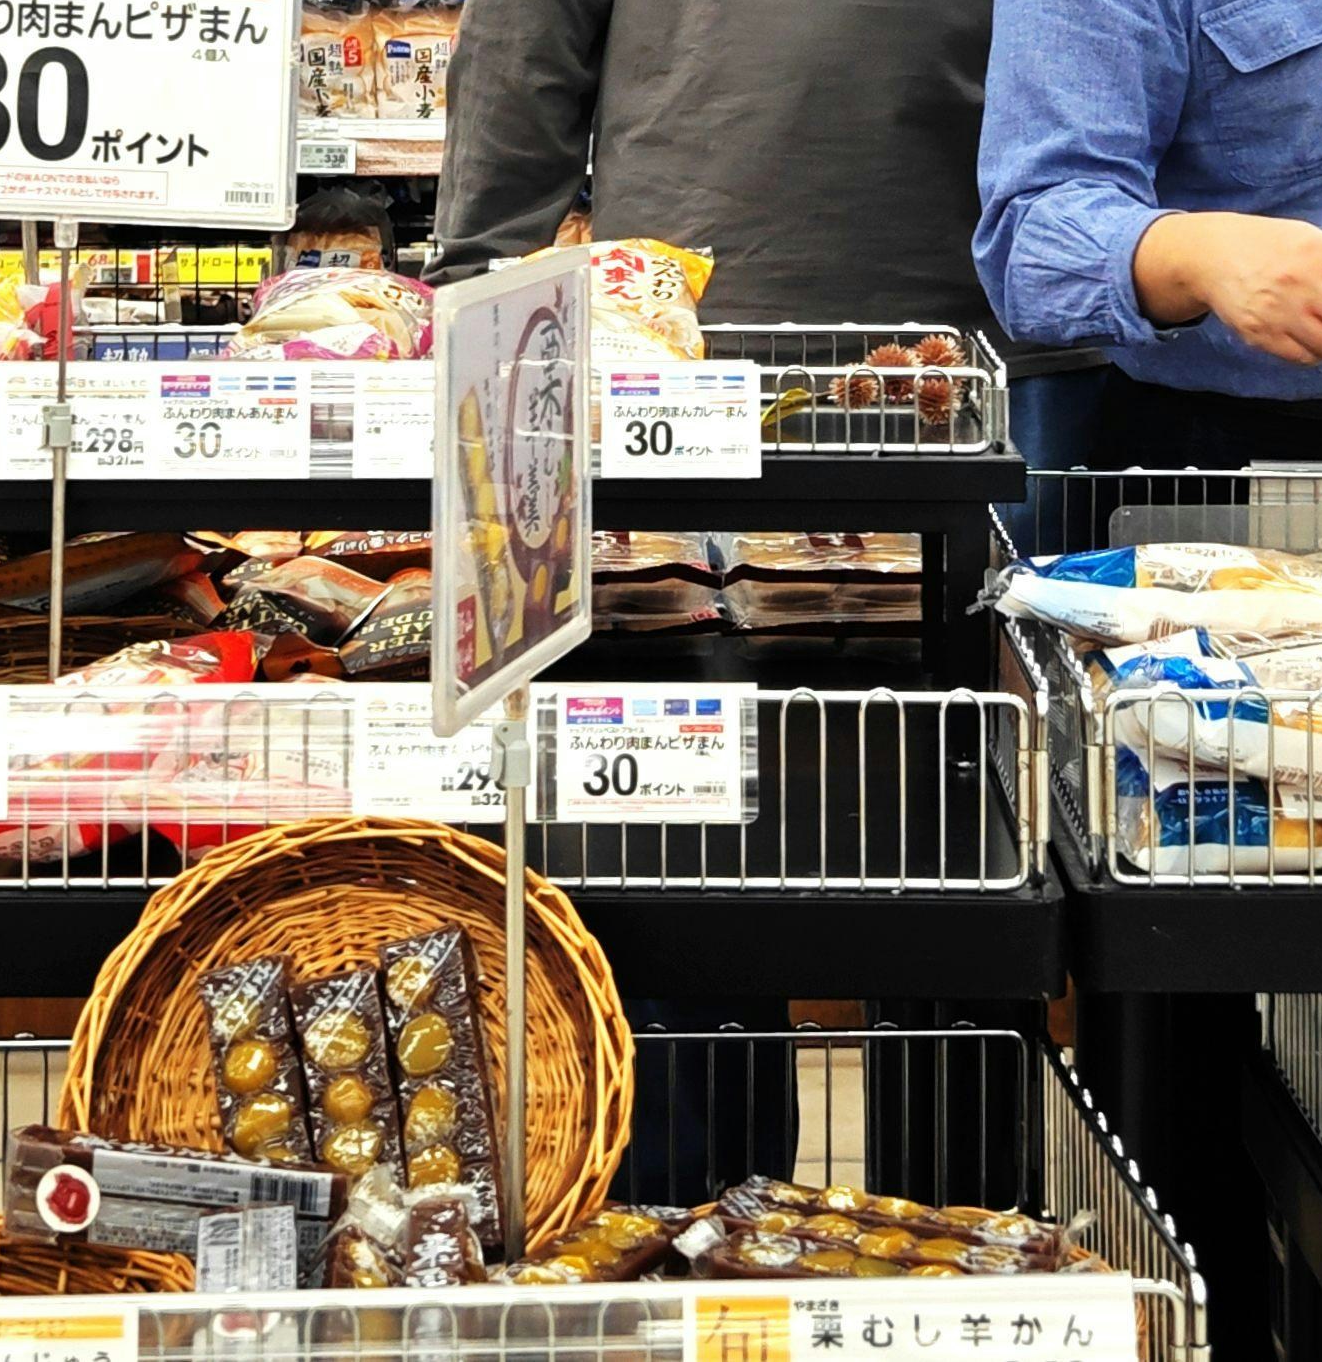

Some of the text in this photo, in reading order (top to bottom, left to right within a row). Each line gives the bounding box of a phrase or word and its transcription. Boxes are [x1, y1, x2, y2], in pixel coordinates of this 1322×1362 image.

[91, 130, 210, 168] ポイント
[613, 405, 748, 420] ふんわり肉まんカレーまん
[173, 421, 222, 459] 30
[625, 420, 674, 457] 30
[568, 733, 725, 752] ふんわり肉まんピザまん
[456, 760, 506, 792] 29
[582, 753, 686, 797] 30 ポイント
[810, 1313, 1096, 1351] 栗むし羊かん
